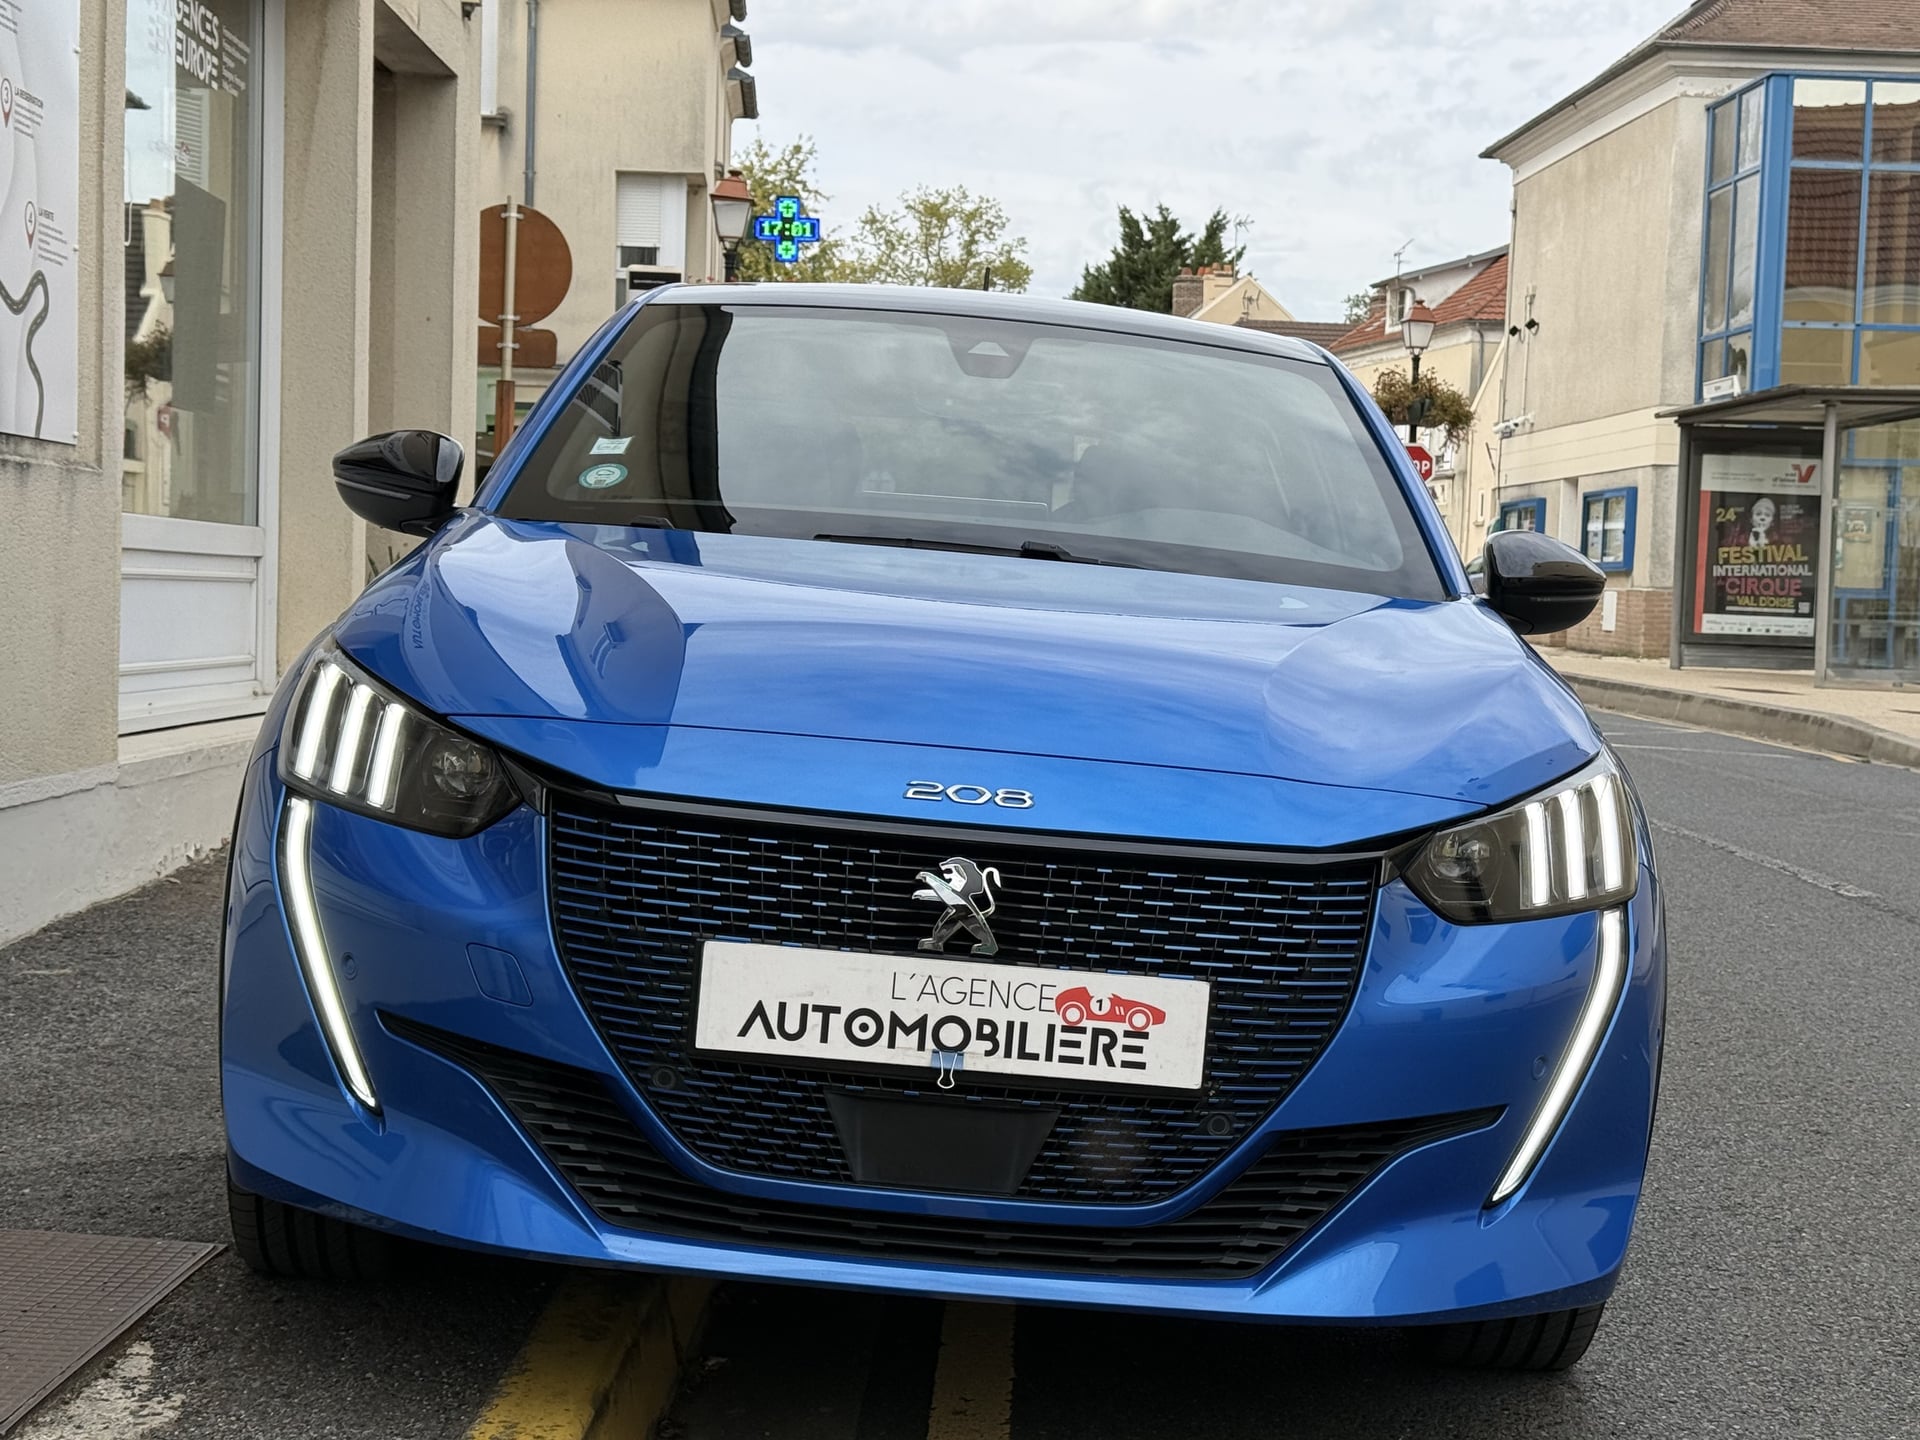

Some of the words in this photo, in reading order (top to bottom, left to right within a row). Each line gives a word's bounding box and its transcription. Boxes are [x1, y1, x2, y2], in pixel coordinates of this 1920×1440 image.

[176, 28, 219, 91] EUROPE
[761, 221, 812, 237] 17:01
[1715, 507, 1737, 522] 24
[1718, 544, 1809, 564] FESTIVAL
[1712, 564, 1813, 577] INTERNATIONAL
[1725, 577, 1803, 596] CIRQUE
[1736, 595, 1758, 607] VAL
[903, 780, 1036, 809] 208
[891, 971, 1057, 1013] L'AGENCE
